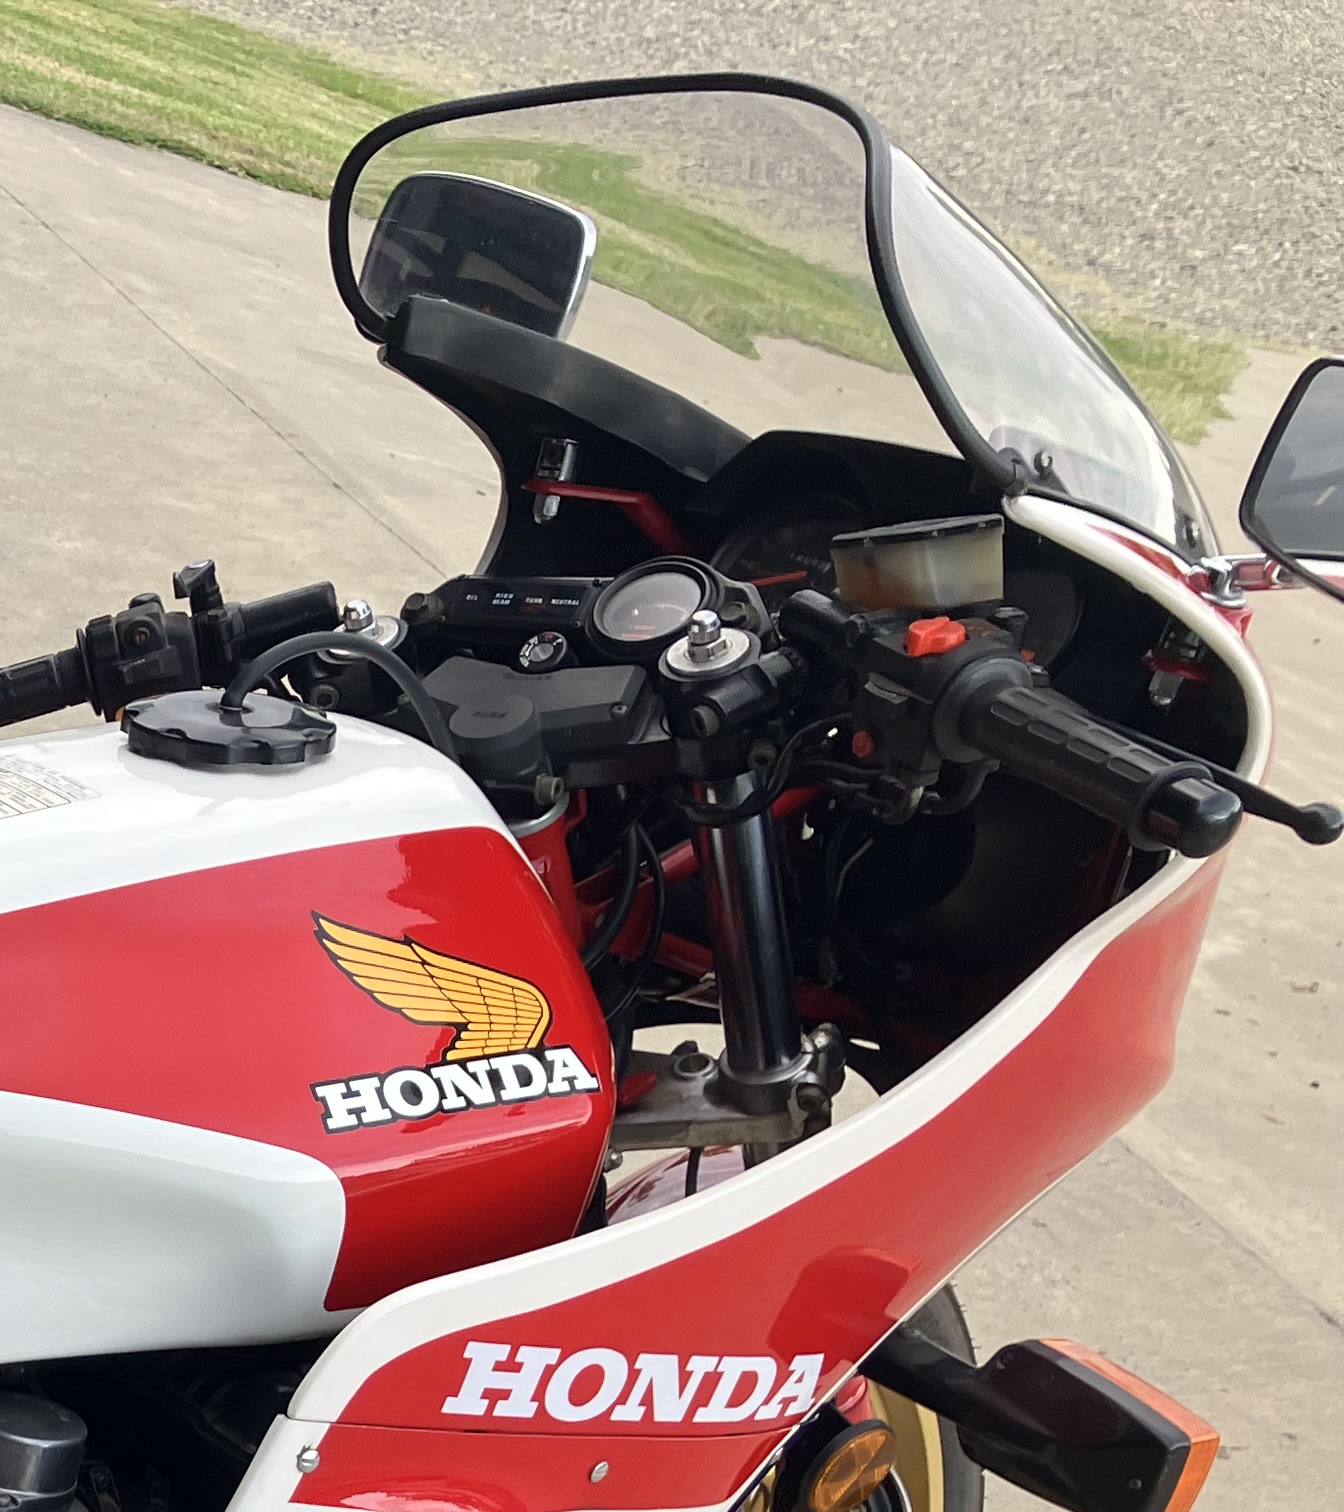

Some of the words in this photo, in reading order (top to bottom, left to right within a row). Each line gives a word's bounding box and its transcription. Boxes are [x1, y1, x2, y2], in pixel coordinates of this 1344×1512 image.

[550, 598, 580, 606] NEUTRAL
[314, 1046, 600, 1131] HONDA
[441, 1340, 825, 1424] HONDA
